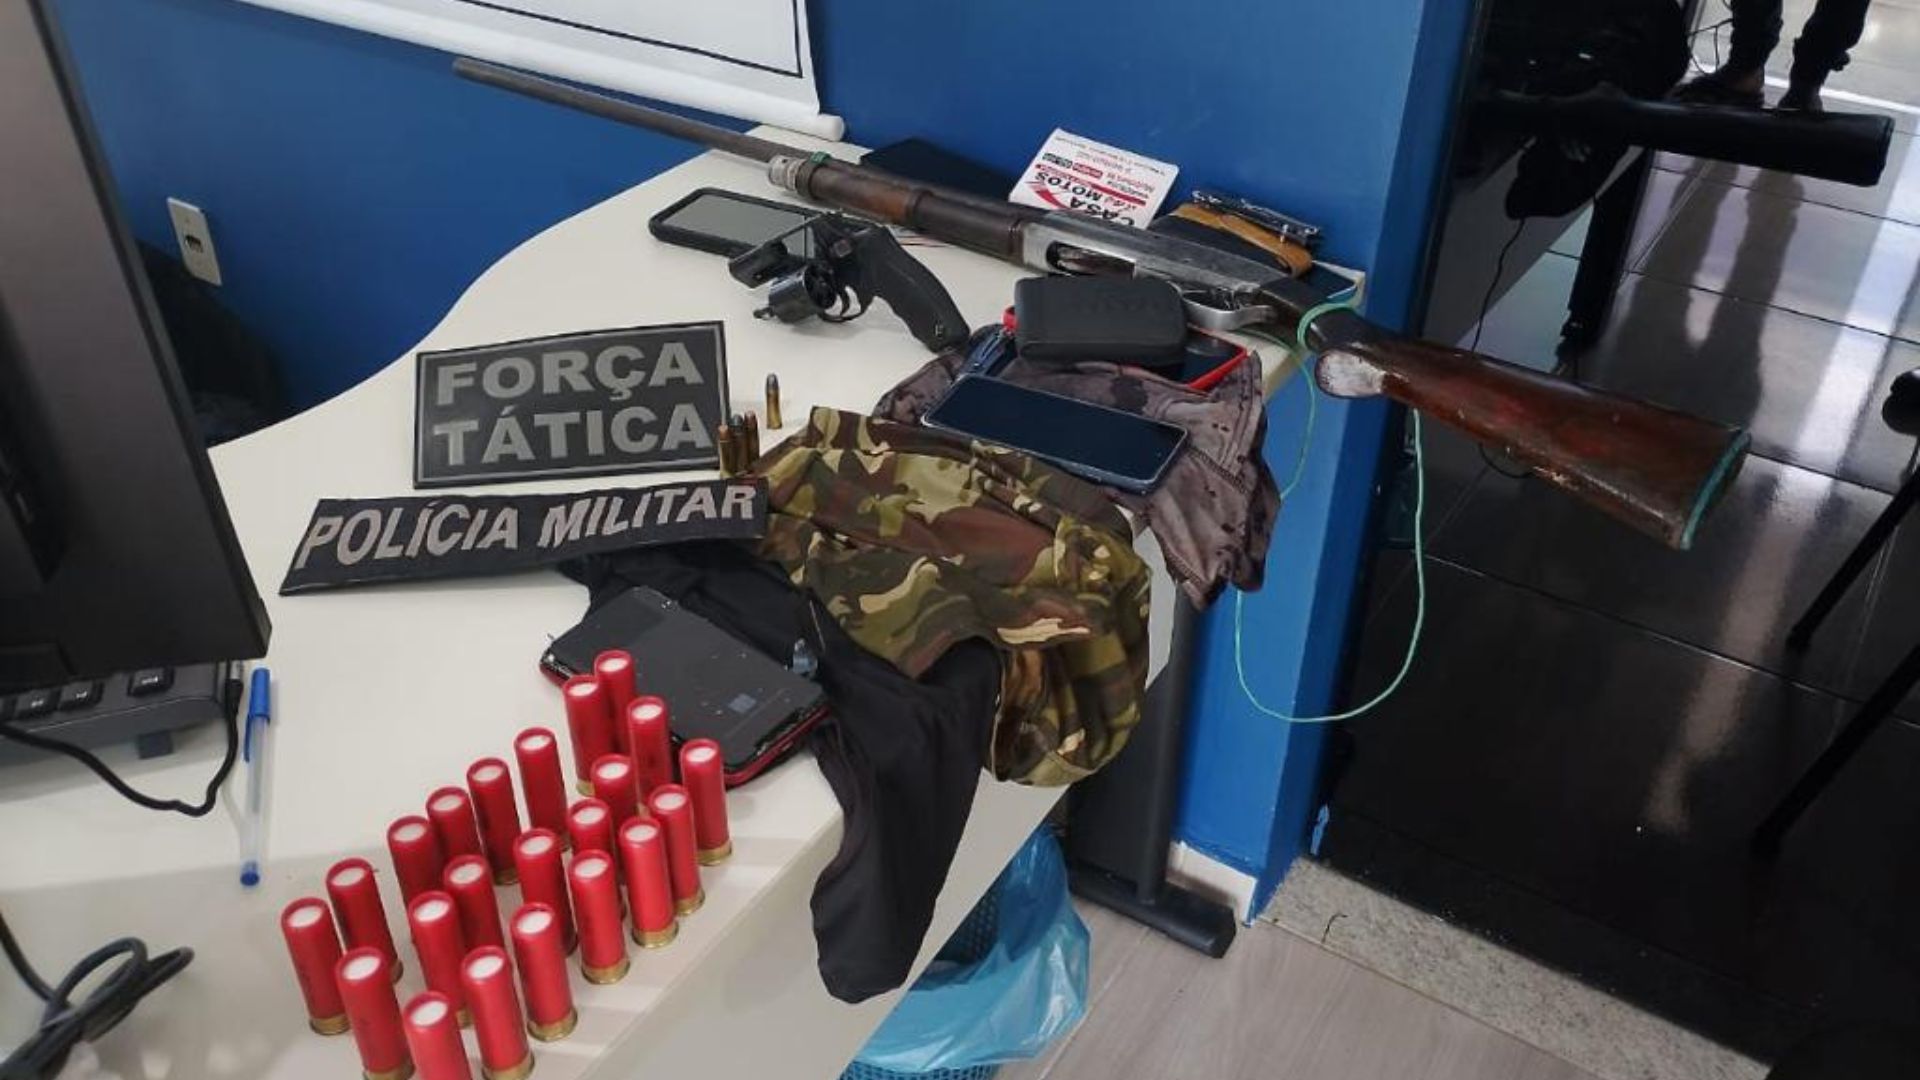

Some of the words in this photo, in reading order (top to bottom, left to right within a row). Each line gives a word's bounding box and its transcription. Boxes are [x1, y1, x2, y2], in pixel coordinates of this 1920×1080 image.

[1034, 171, 1102, 200] MOTOS
[1069, 196, 1135, 226] CASA
[436, 342, 704, 406] FORÇA
[432, 402, 714, 467] TÁTICA
[299, 501, 519, 569] POLÍCIA
[536, 484, 756, 549] MILITAR
